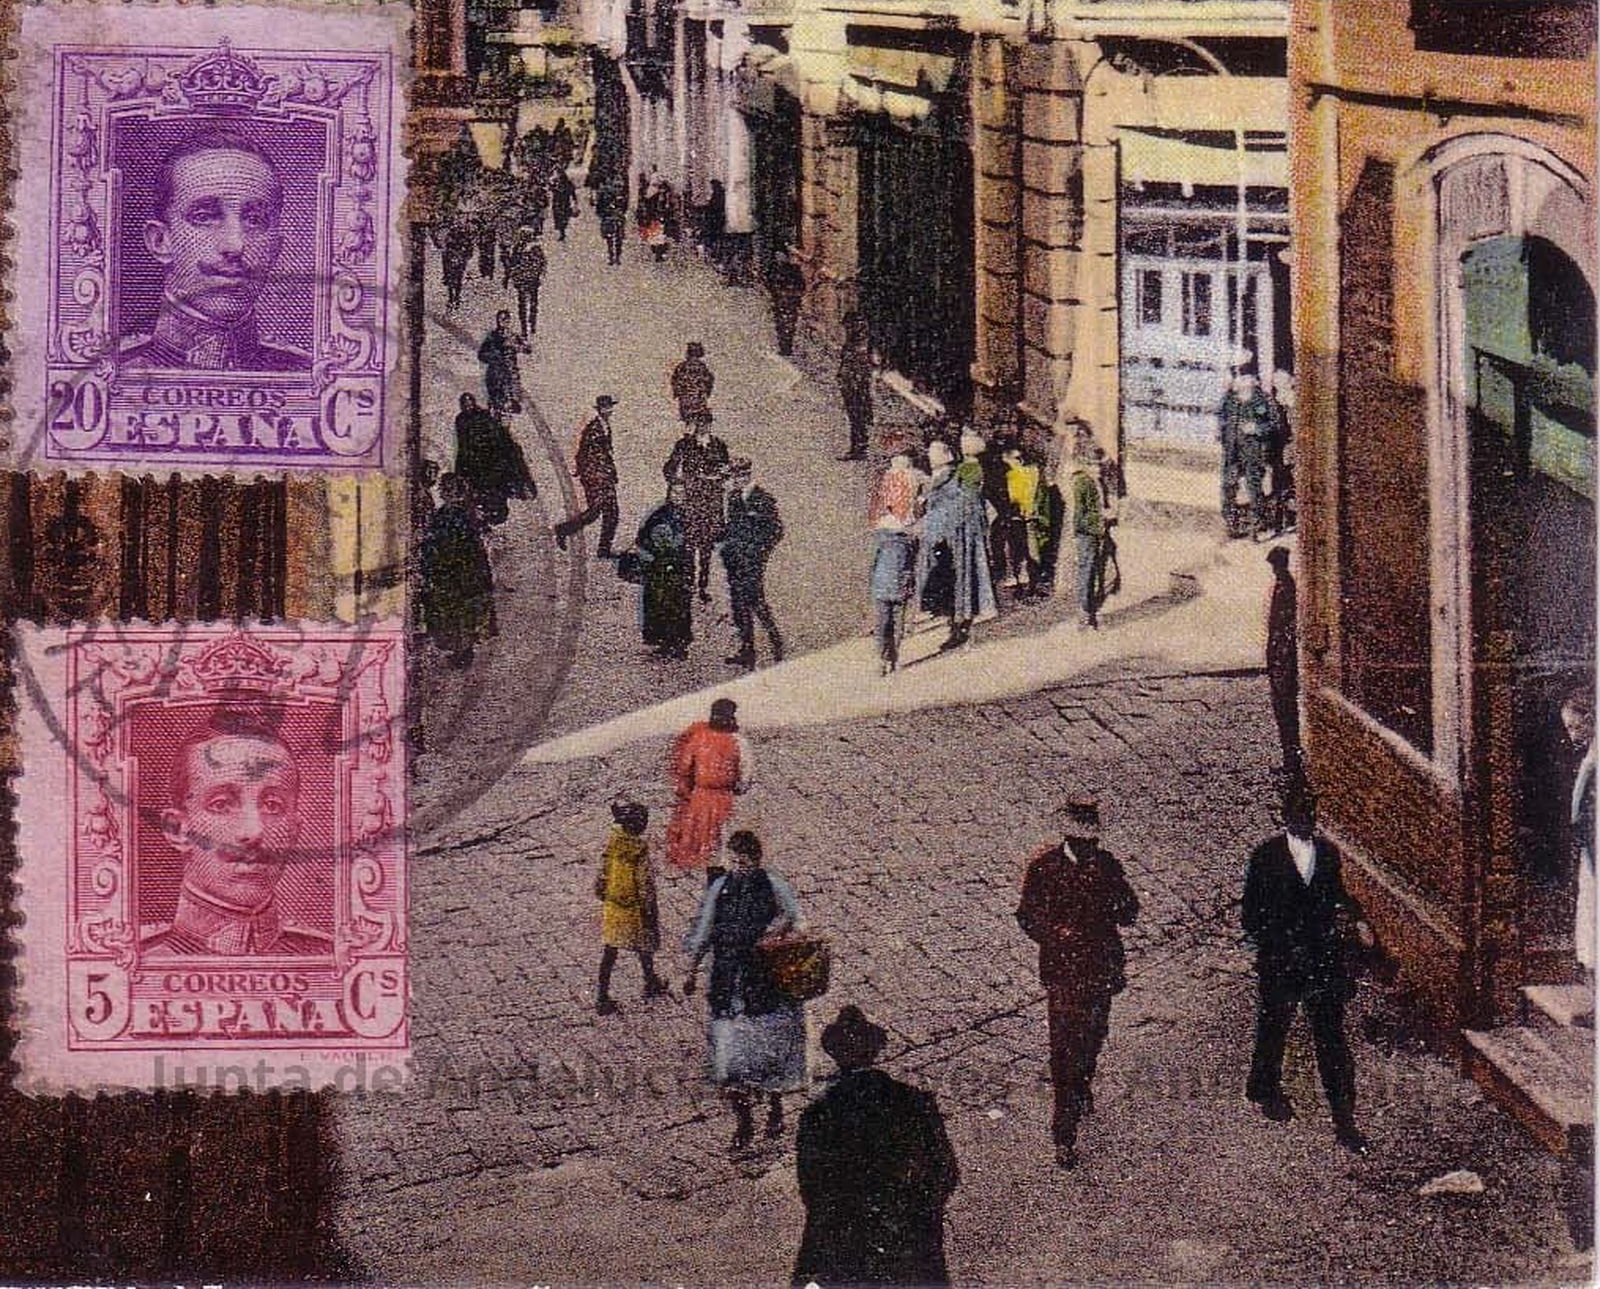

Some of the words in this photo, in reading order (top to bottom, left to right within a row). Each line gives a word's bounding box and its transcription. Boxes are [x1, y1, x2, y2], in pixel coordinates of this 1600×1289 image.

[50, 380, 102, 433] 20
[142, 387, 288, 409] CORREOS
[85, 973, 113, 1025] 5
[162, 973, 310, 993] CORREOS
